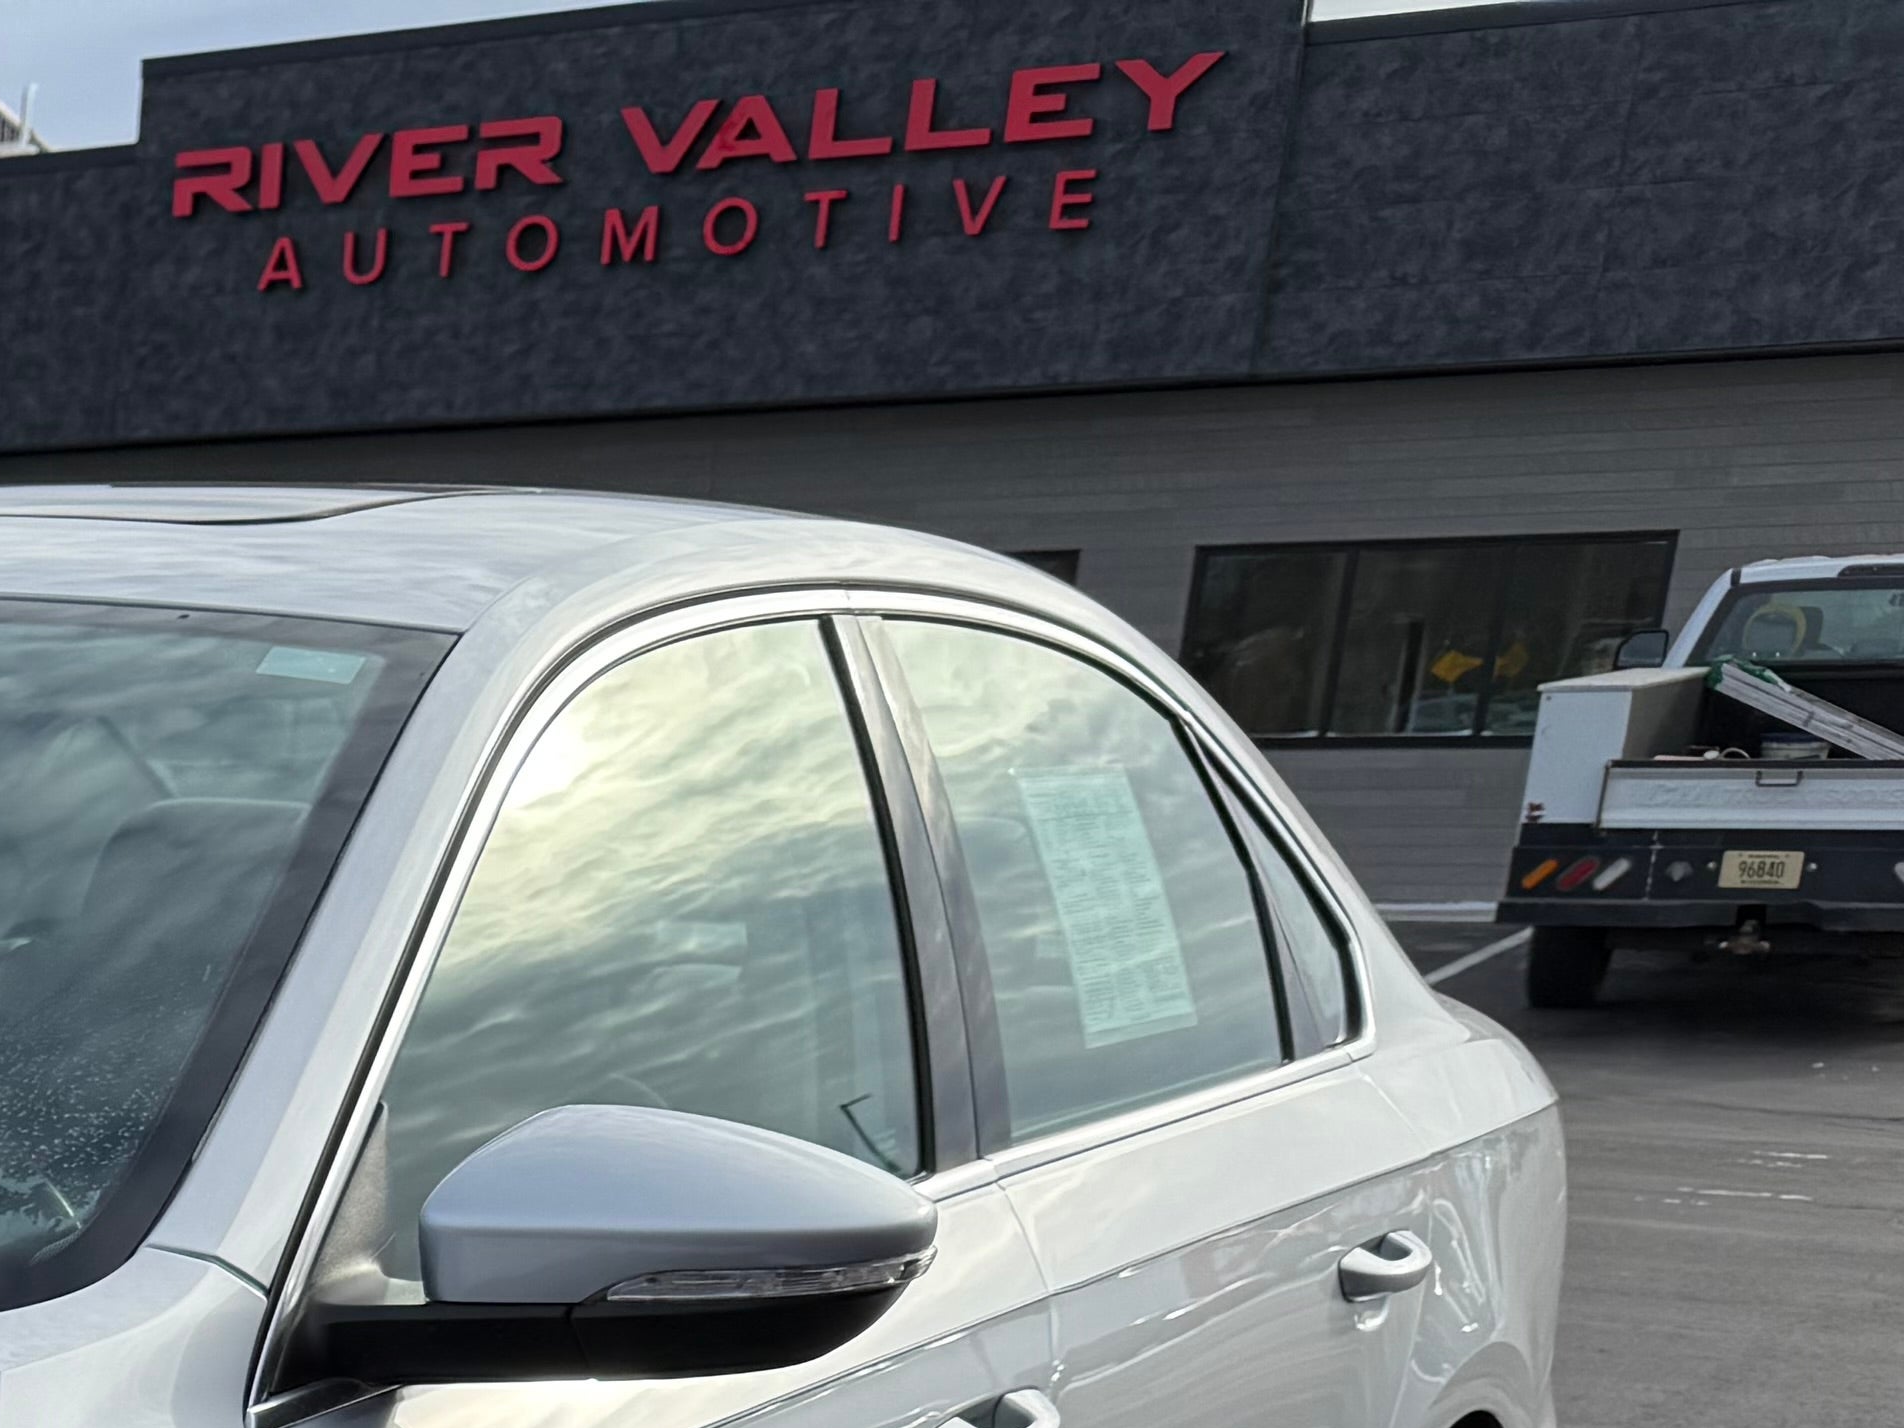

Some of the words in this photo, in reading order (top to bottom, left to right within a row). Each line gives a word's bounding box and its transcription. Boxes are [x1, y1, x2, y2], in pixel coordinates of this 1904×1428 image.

[172, 115, 564, 217] RIVER
[622, 51, 1223, 173] VALLEY
[258, 169, 1097, 291] AUTOMOTIVE
[1738, 860, 1785, 878] 96840
